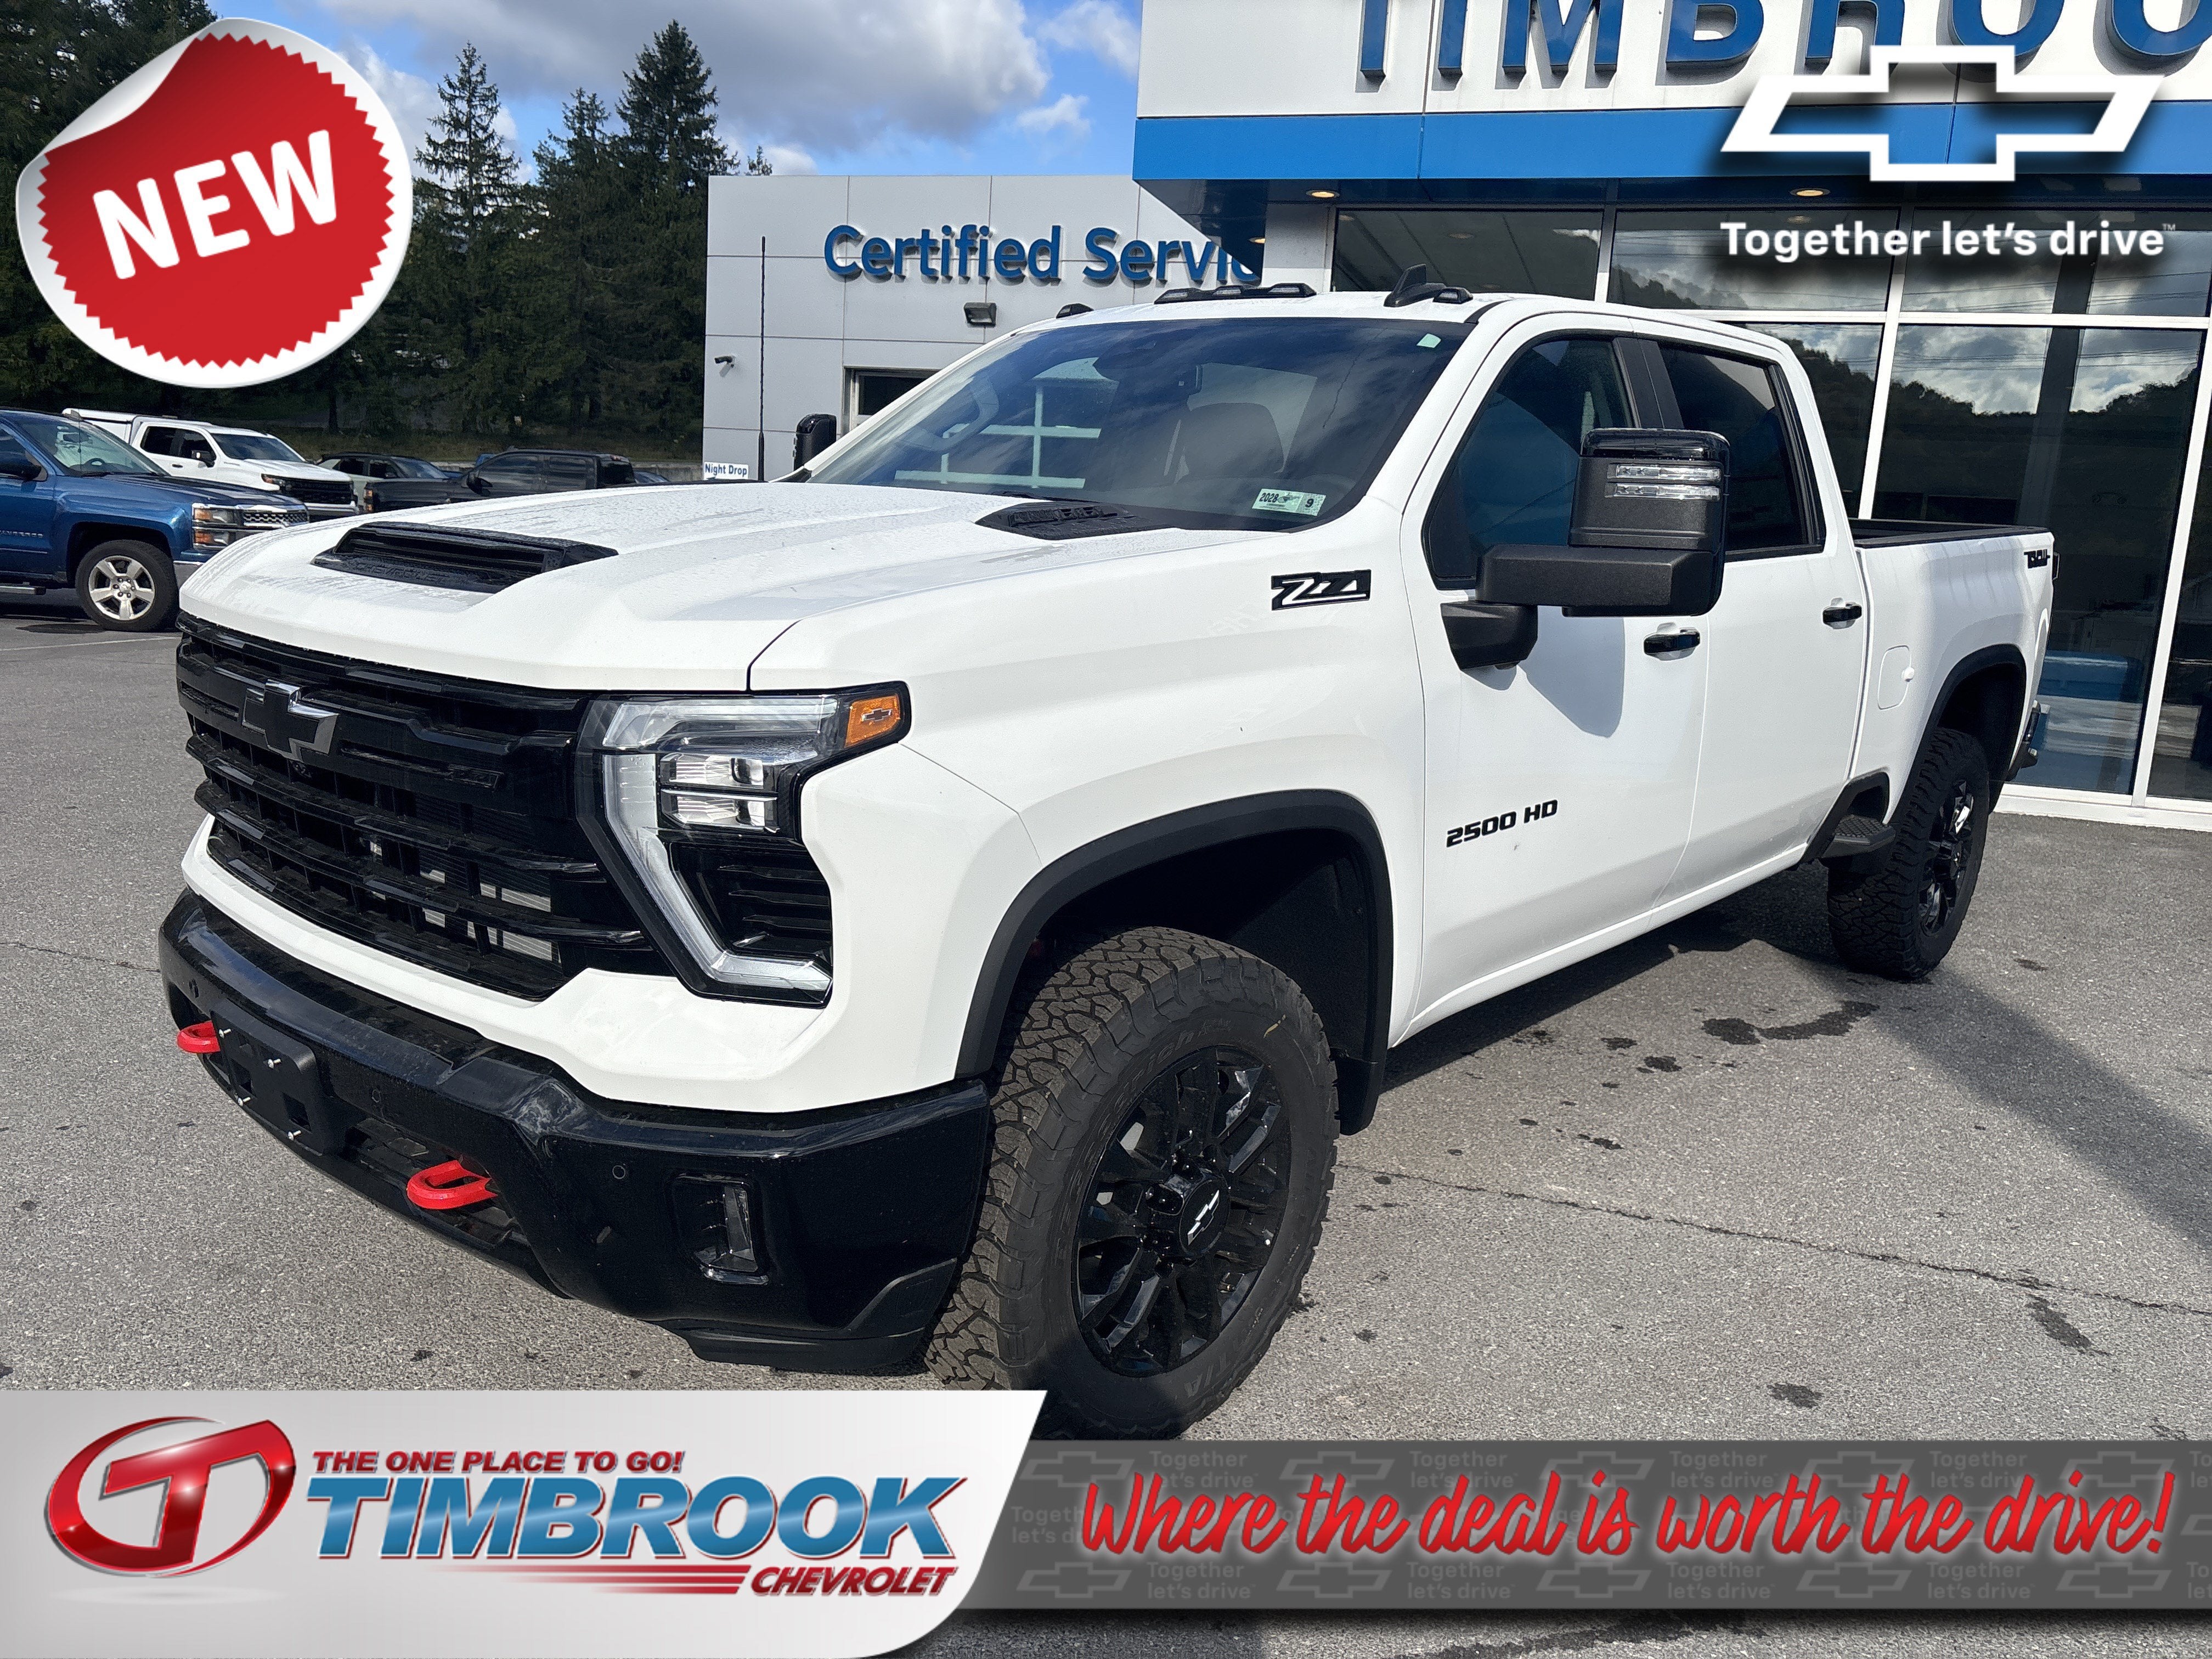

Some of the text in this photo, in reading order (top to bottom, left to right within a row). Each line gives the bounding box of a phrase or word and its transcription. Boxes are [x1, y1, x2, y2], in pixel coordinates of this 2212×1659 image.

[824, 224, 1063, 282] Certified
[705, 463, 747, 478] Night Drop
[1259, 492, 1314, 508] 2028 9
[1446, 799, 1558, 848] 2500 HD
